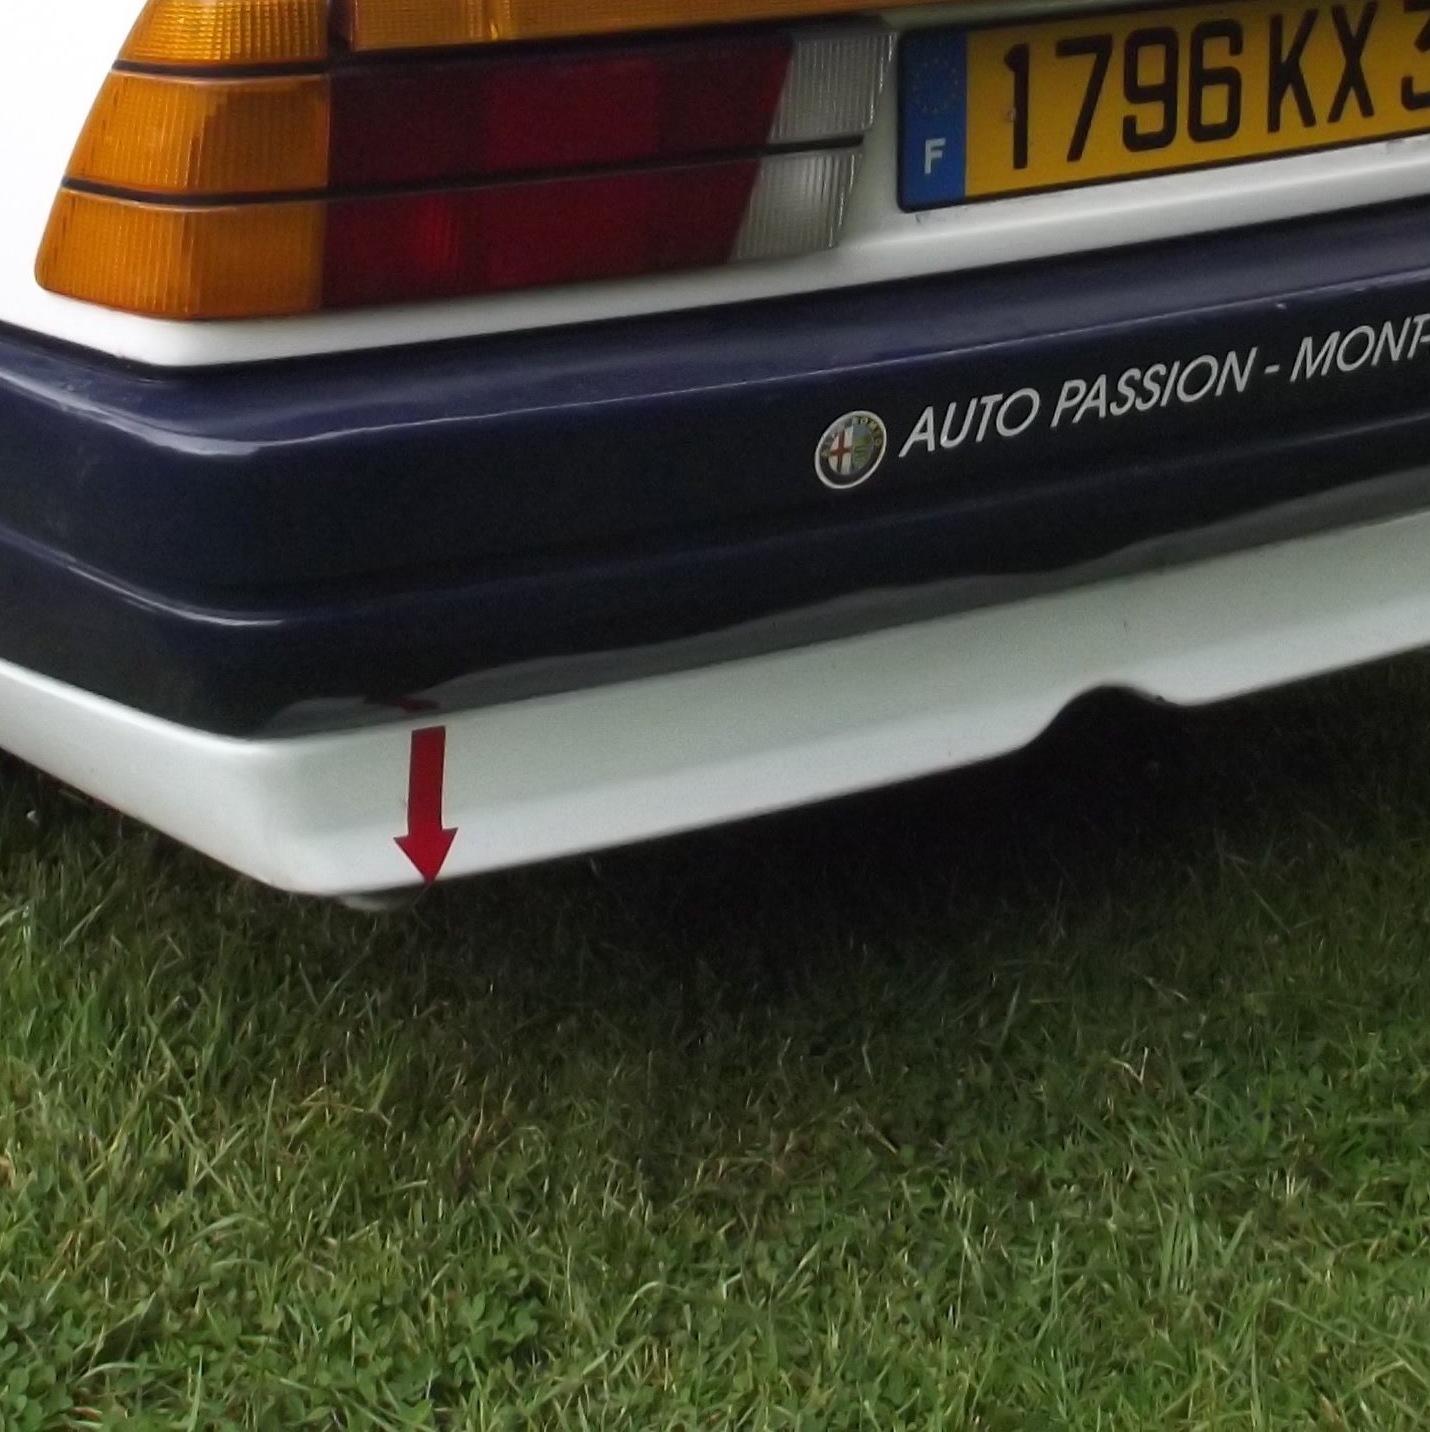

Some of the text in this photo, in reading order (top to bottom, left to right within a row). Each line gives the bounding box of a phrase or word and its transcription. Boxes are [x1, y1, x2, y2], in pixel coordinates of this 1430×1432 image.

[1004, 18, 1245, 171] 1796
[1266, 0, 1379, 134] KX
[923, 137, 947, 175] F
[898, 388, 1041, 458] AUTO
[1050, 346, 1259, 429] PASSION
